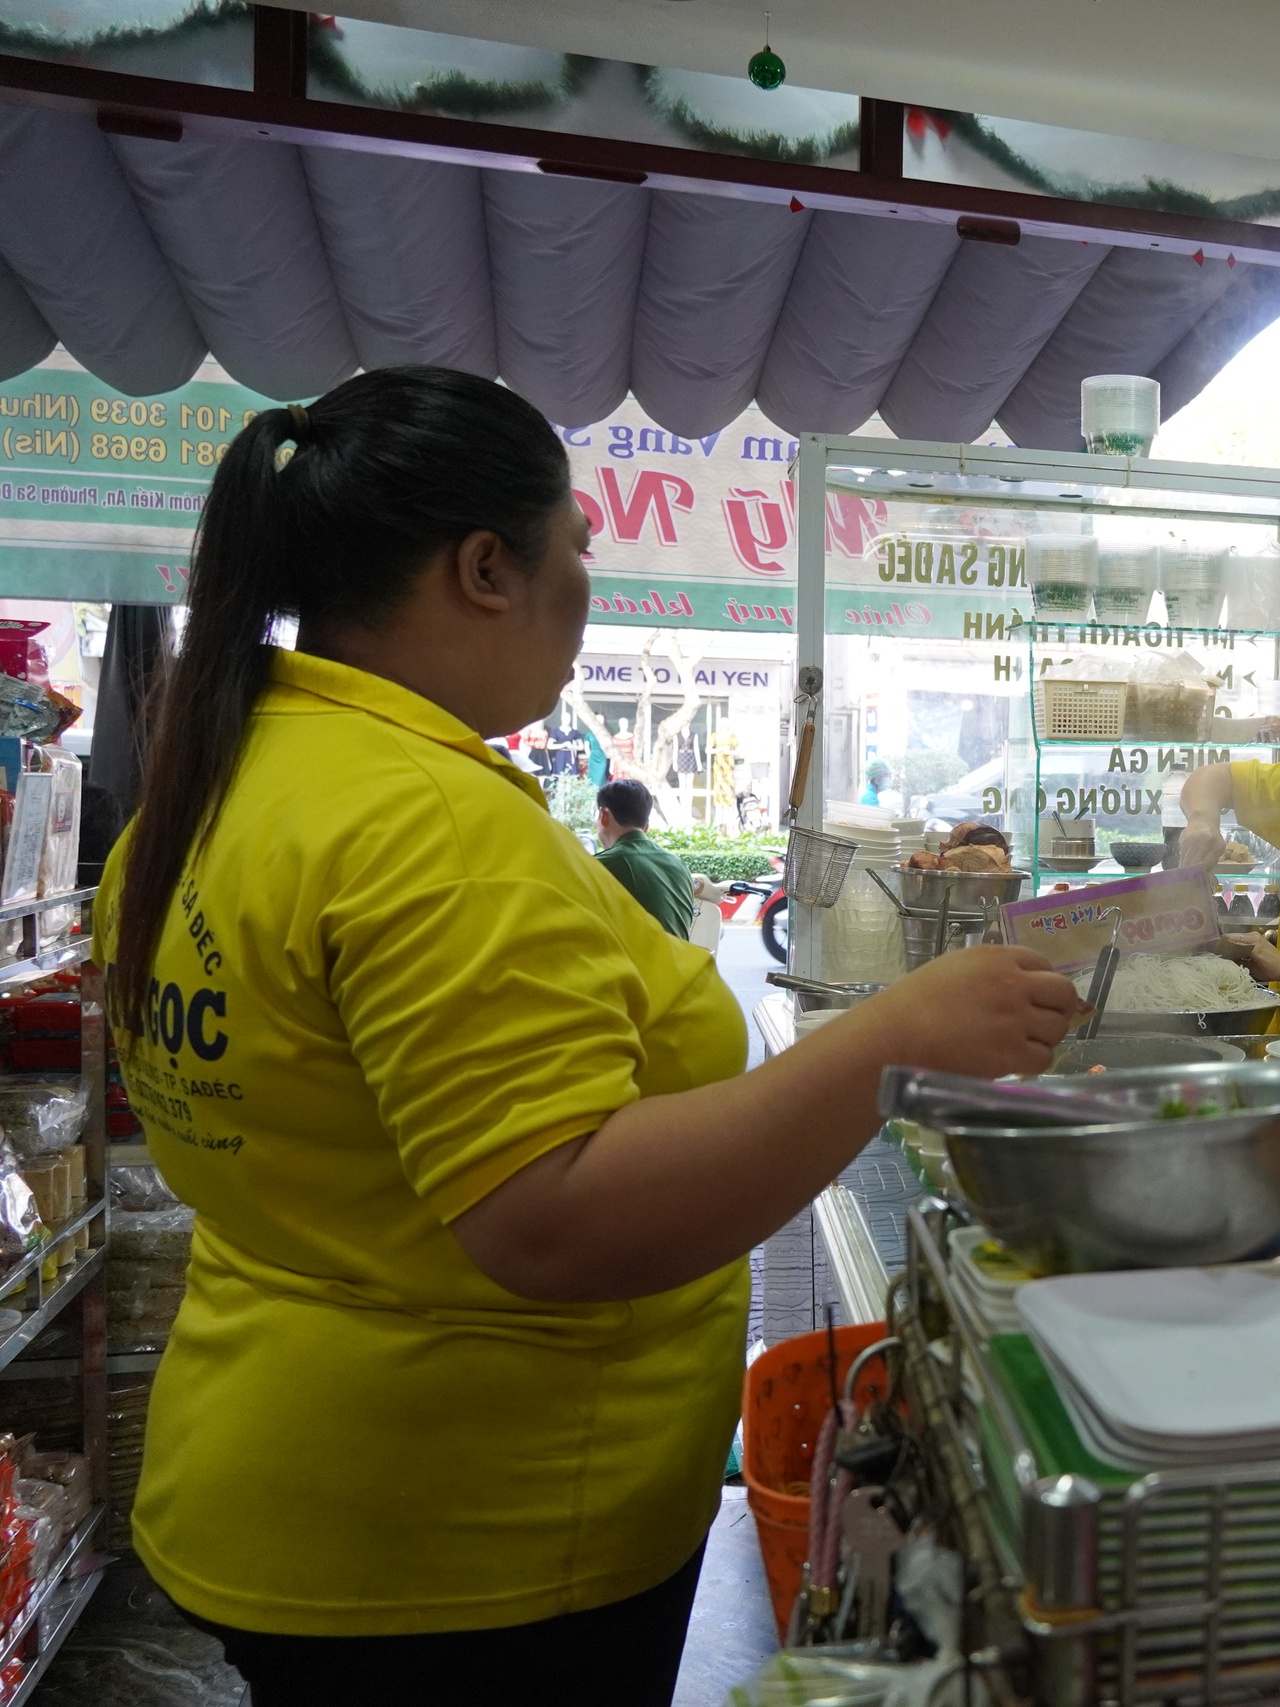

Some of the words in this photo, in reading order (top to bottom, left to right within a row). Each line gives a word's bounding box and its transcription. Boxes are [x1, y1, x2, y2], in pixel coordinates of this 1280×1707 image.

[678, 669, 716, 686] AI
[722, 670, 769, 688] YEN
[150, 976, 229, 1070] GỌC
